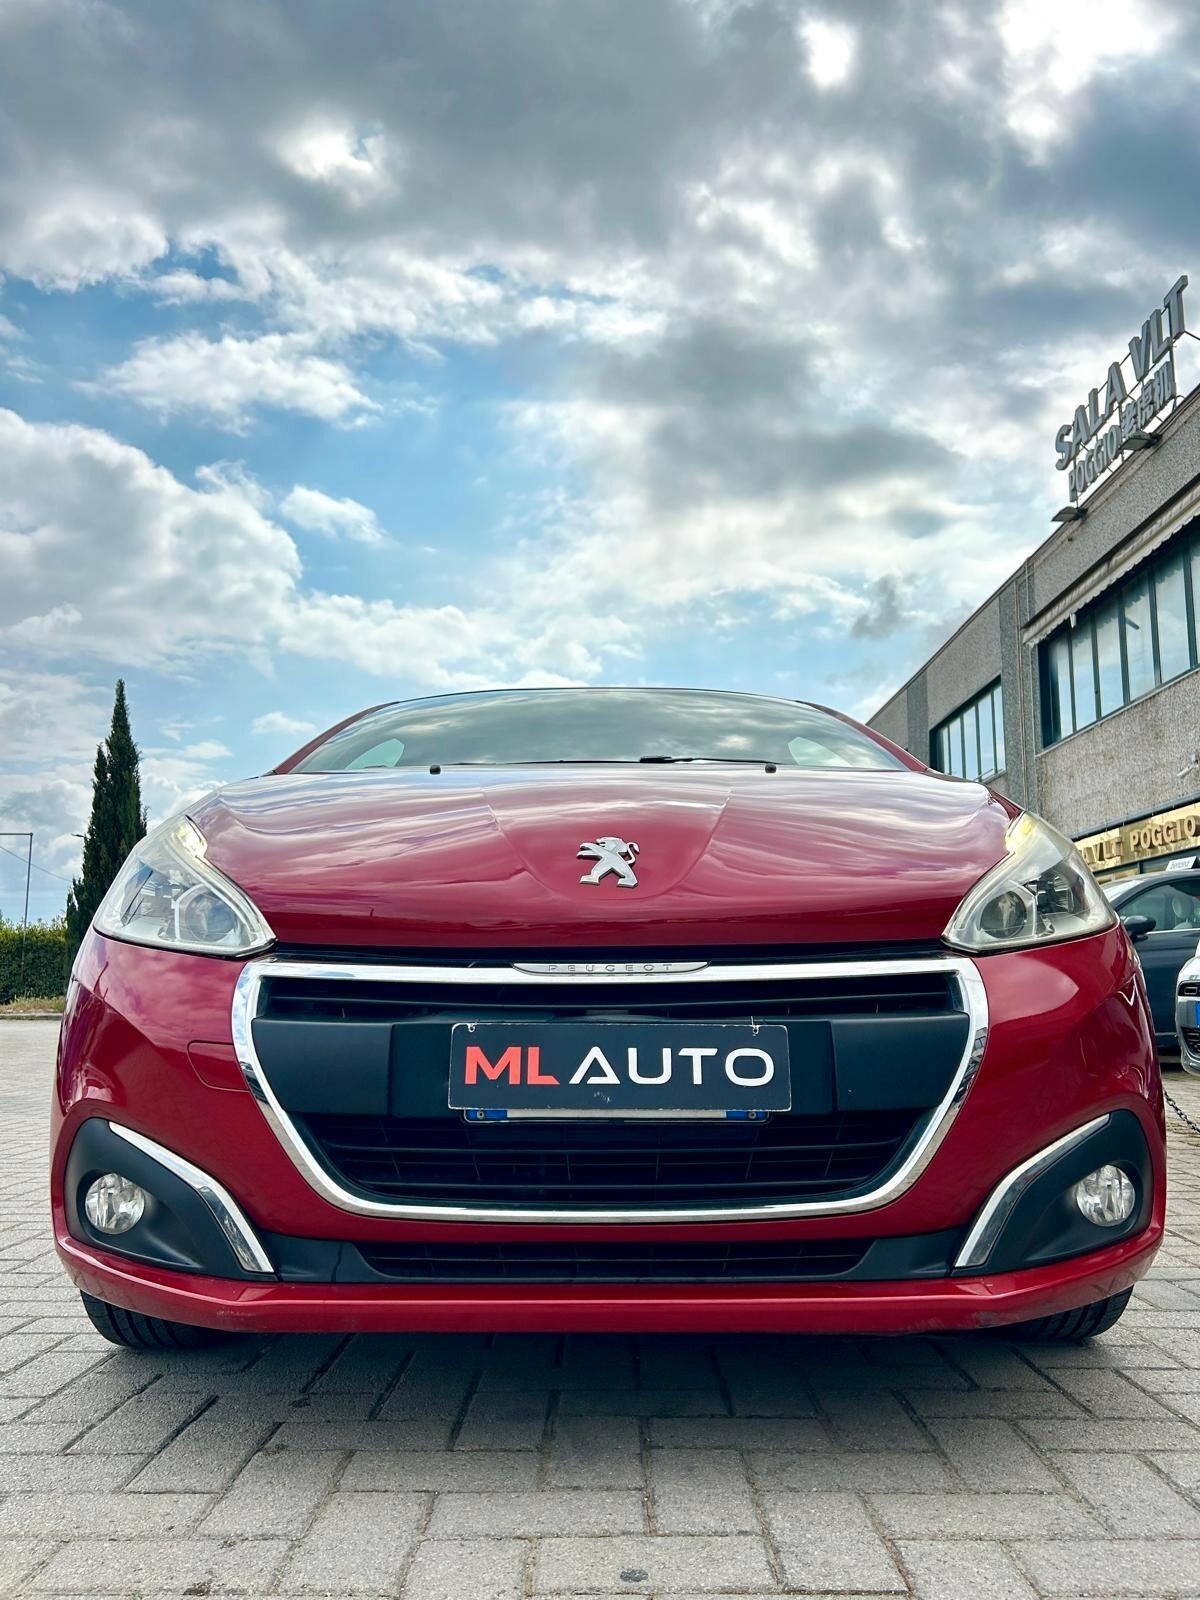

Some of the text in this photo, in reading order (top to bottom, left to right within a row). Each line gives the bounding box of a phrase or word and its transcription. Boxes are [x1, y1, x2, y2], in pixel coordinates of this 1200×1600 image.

[1055, 275, 1189, 471] SALA VLT
[1068, 424, 1122, 503] POGGIO
[1129, 815, 1200, 852] POGGIO
[548, 963, 673, 973] PEUGEOT
[464, 1045, 775, 1087] ML AUTO
